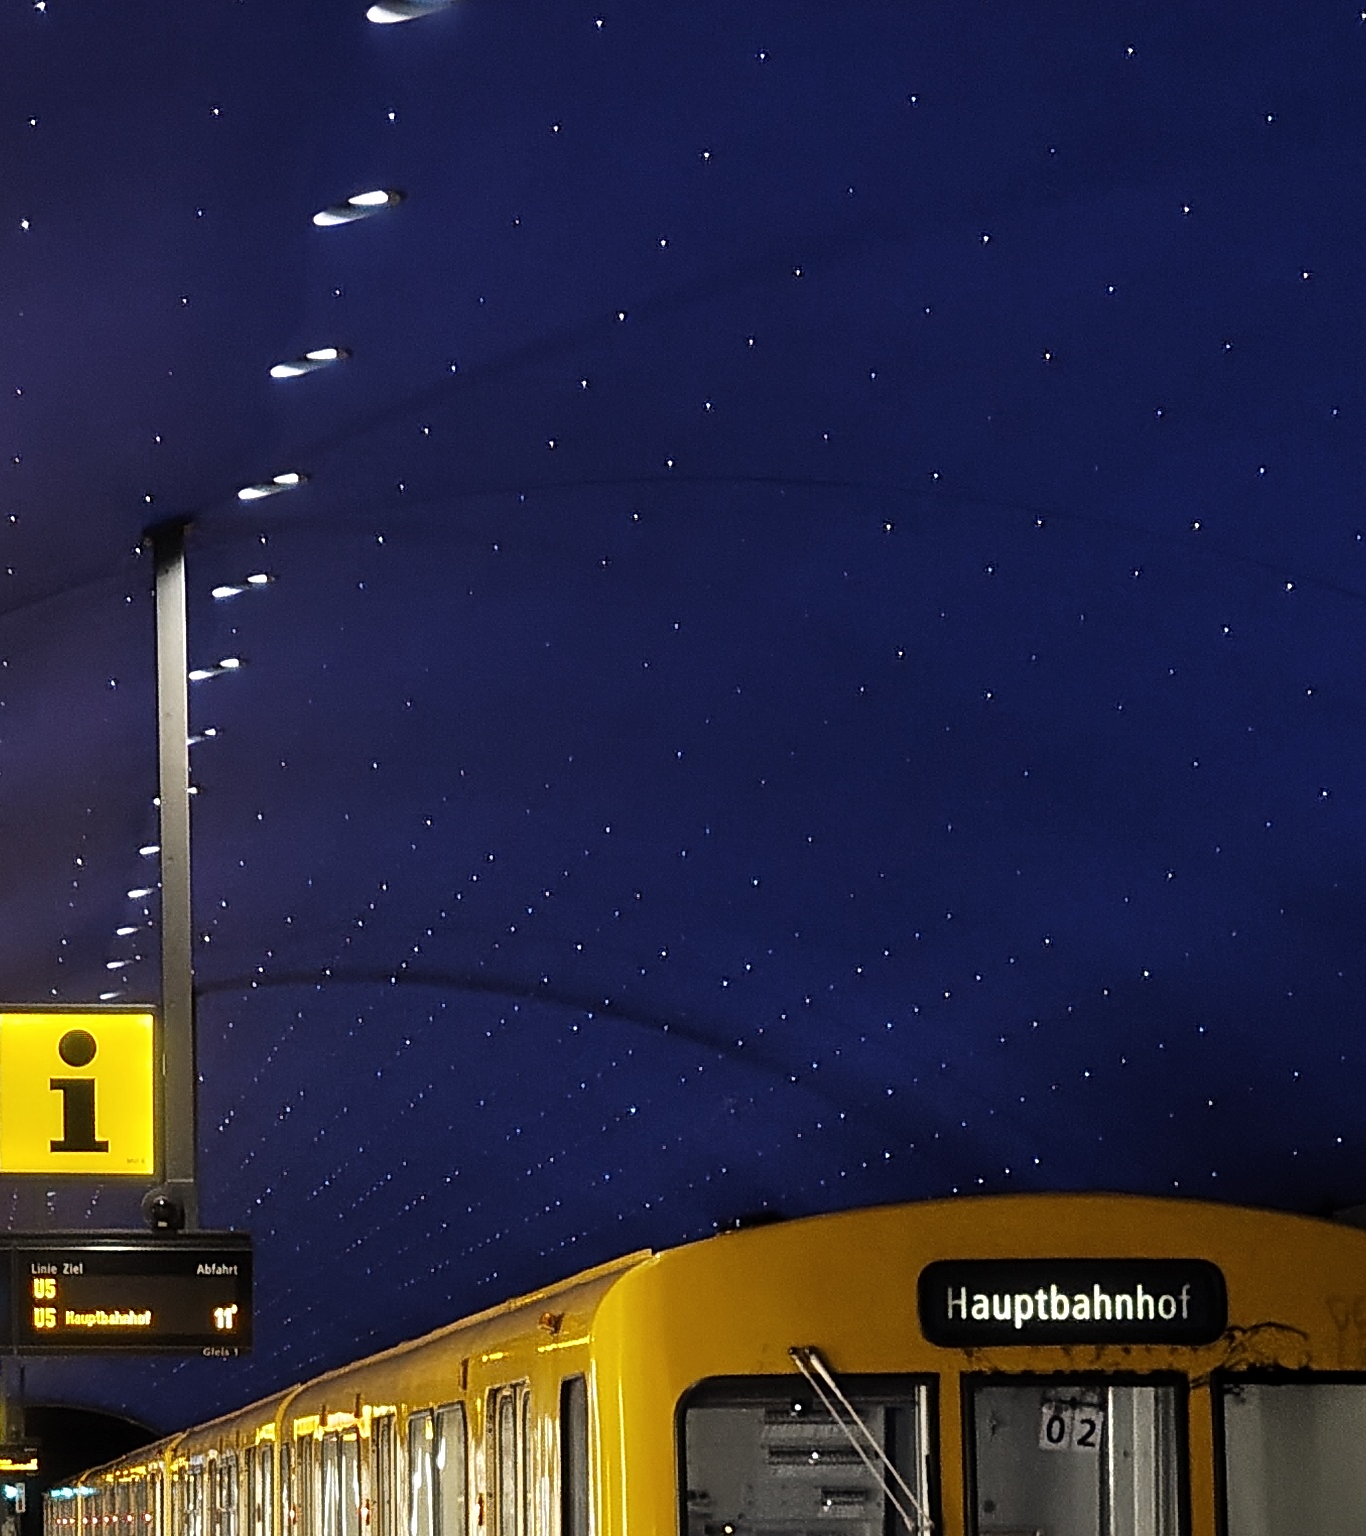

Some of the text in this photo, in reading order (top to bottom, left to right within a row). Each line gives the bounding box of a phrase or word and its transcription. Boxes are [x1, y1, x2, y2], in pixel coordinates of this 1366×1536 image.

[31, 1262, 238, 1275] Linie Ziel Abfahrt
[34, 1278, 56, 1298] U5
[947, 1284, 1191, 1329] Hauptbahnhof
[34, 1307, 56, 1328] U5
[65, 1310, 152, 1327] Hauptbahnhof
[1046, 1415, 1097, 1447] 02
